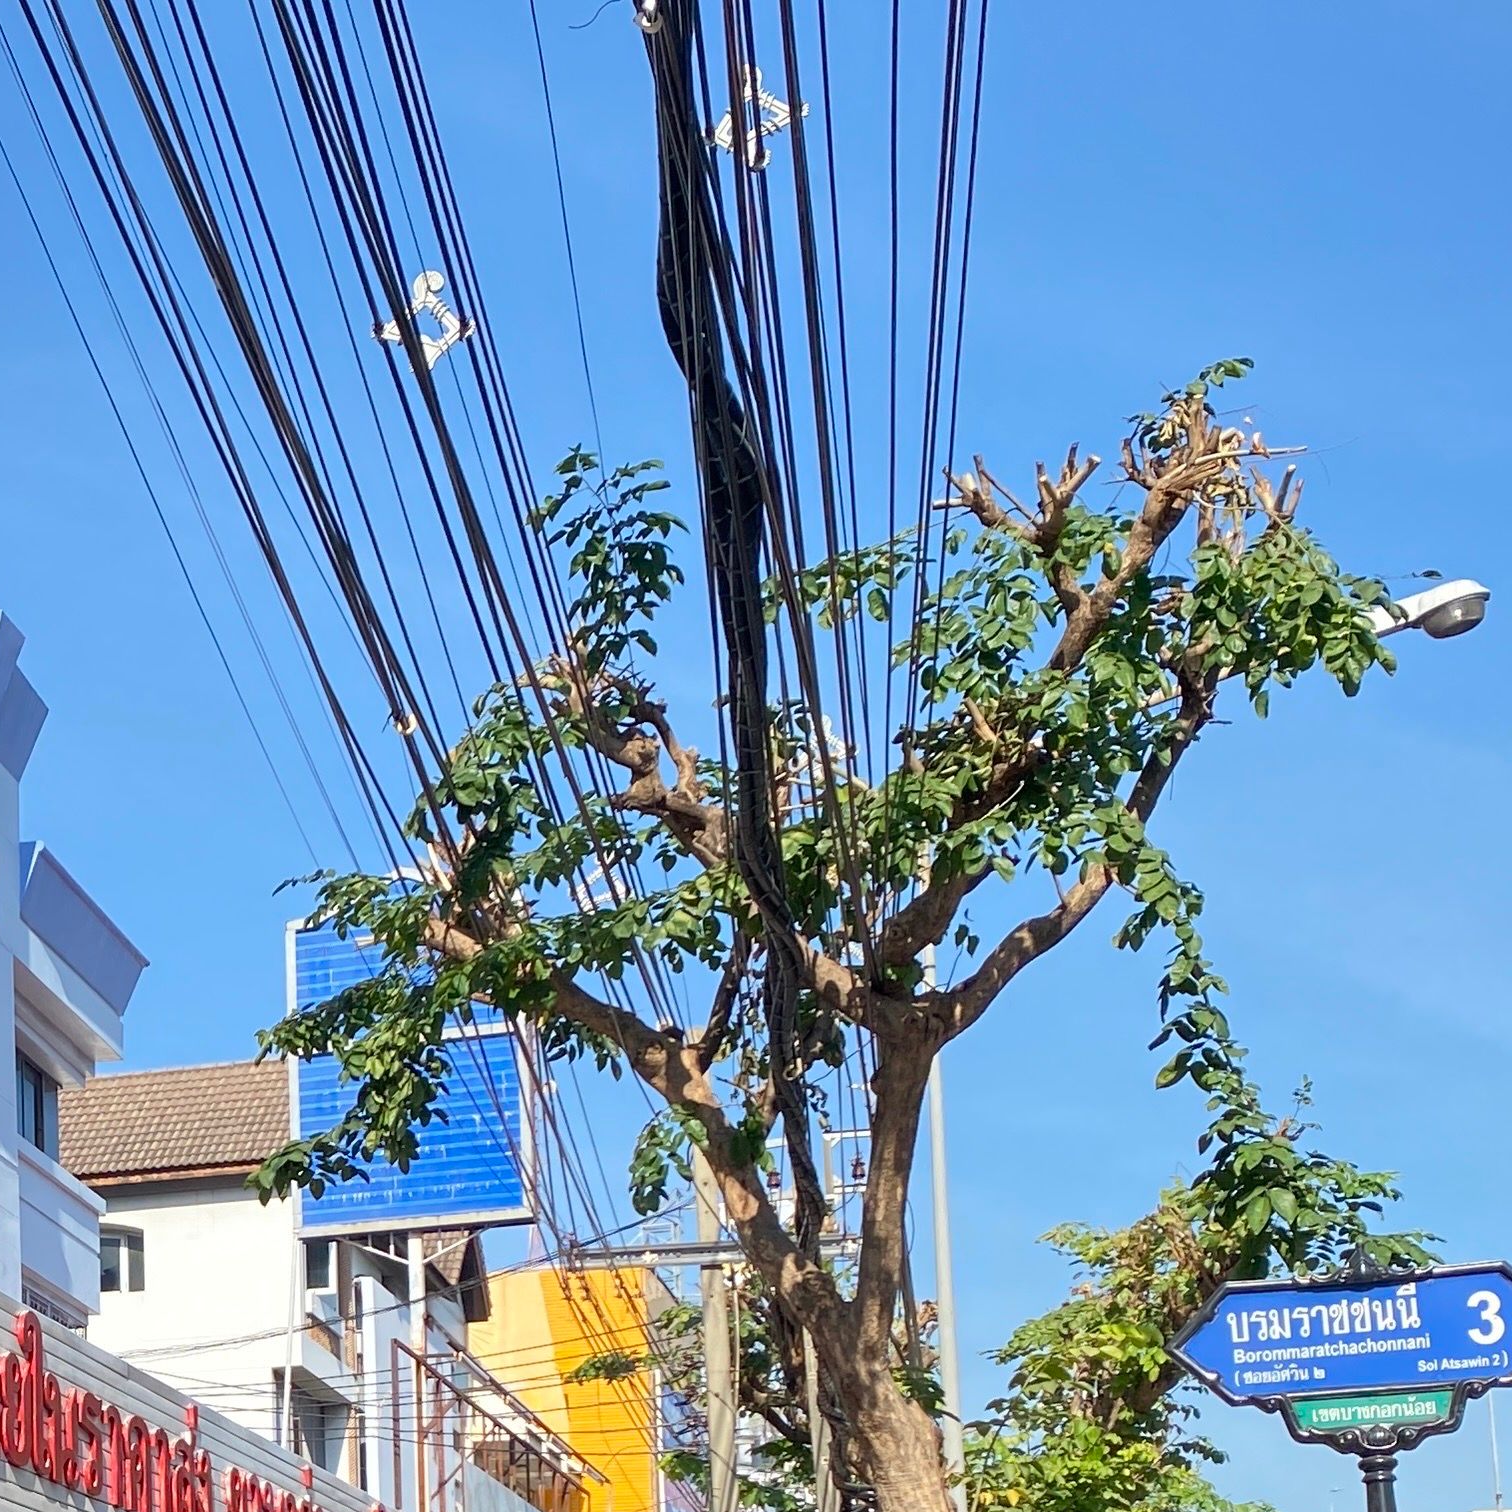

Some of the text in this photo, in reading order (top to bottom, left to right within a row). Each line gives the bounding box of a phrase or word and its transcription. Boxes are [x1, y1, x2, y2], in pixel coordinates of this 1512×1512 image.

[1226, 1283, 1505, 1345] บรมราชชนนี 3
[1234, 1334, 1430, 1364] Borommaratchachonnani
[1441, 1355, 1490, 1370] Atsawin
[1312, 1396, 1437, 1422] เขตบางกอกน้อย
